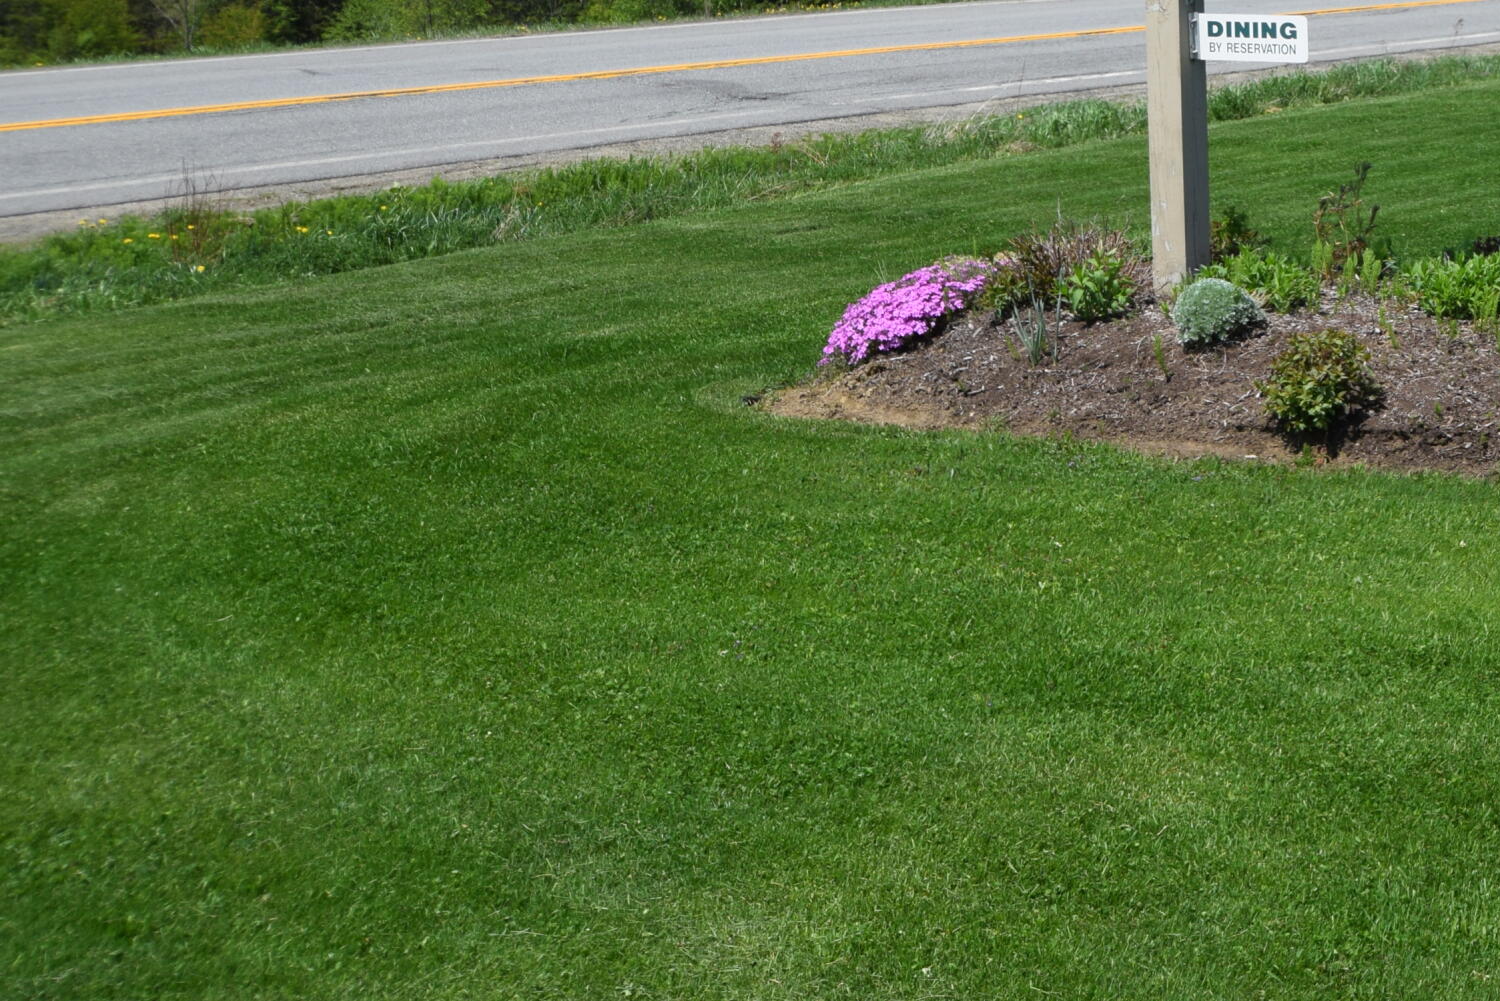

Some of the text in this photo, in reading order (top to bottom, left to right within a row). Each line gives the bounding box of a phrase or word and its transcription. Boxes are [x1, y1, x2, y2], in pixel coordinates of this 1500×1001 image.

[1207, 20, 1298, 40] DINING
[1208, 41, 1297, 56] BY RESERVATION
